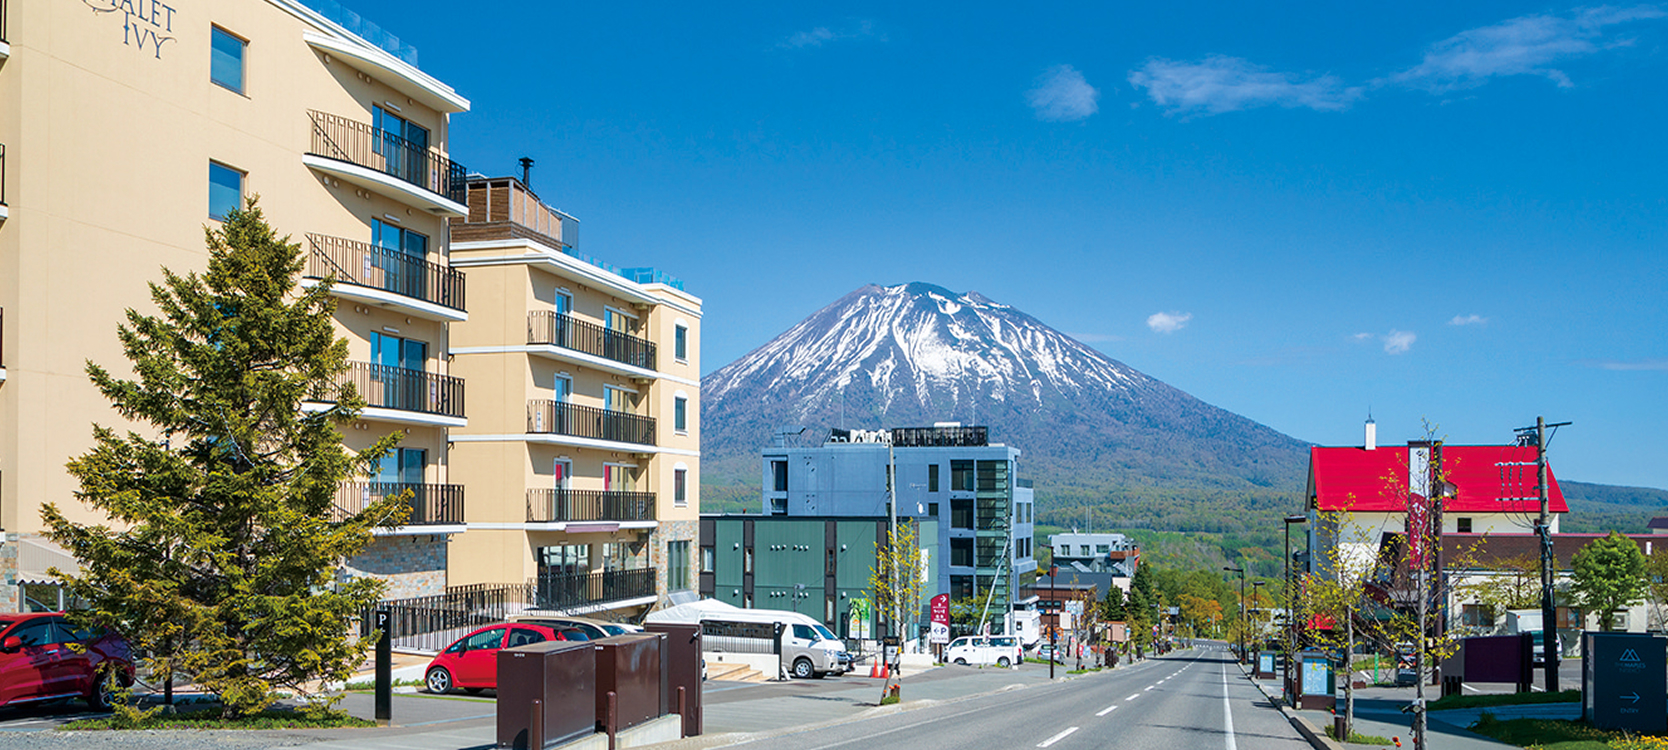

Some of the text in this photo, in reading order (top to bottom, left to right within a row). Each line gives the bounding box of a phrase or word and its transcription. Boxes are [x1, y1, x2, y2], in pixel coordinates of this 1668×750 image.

[123, 11, 177, 60] IVY
[379, 613, 387, 625] P
[940, 627, 947, 635] P
